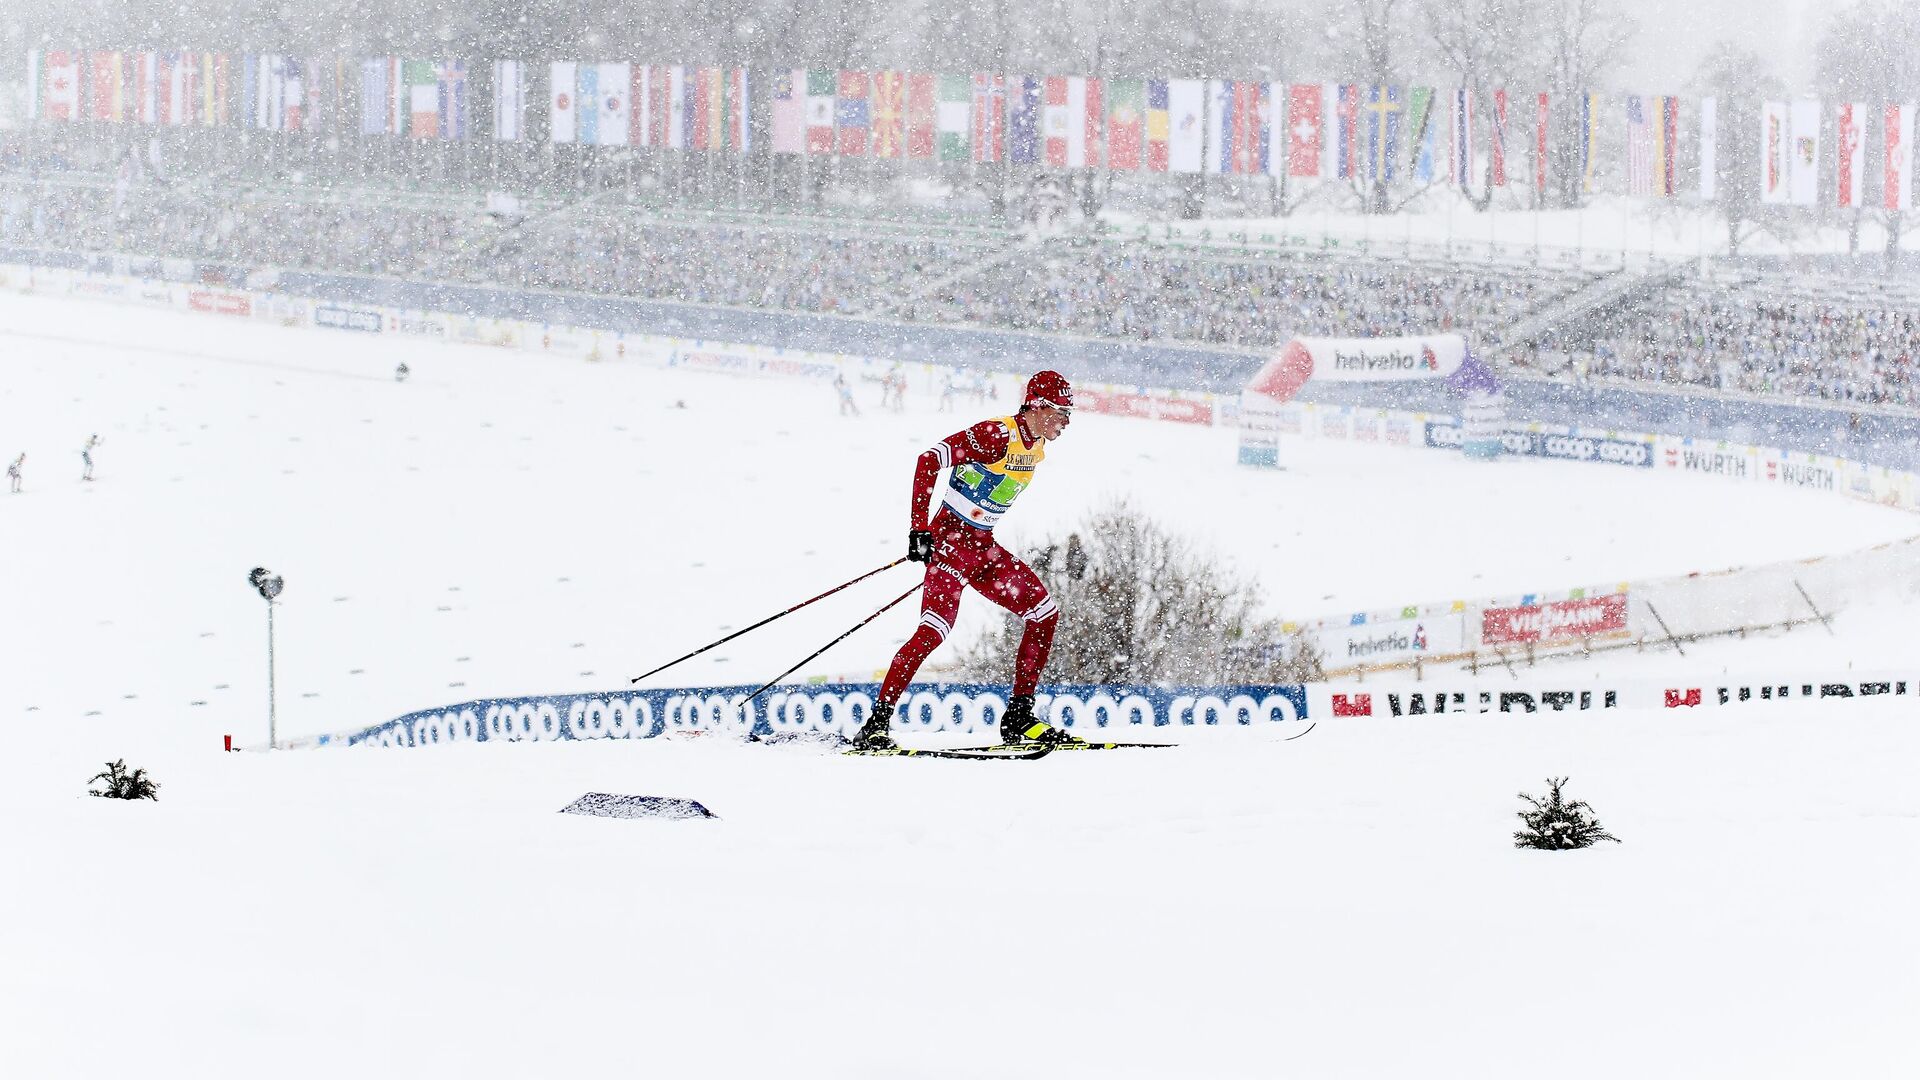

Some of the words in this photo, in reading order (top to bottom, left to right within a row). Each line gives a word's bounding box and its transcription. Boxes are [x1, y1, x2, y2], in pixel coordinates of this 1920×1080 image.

[1335, 349, 1414, 370] helvetia
[1545, 438, 1595, 460] coop
[1597, 440, 1648, 465] coop
[1347, 632, 1409, 657] helvetia
